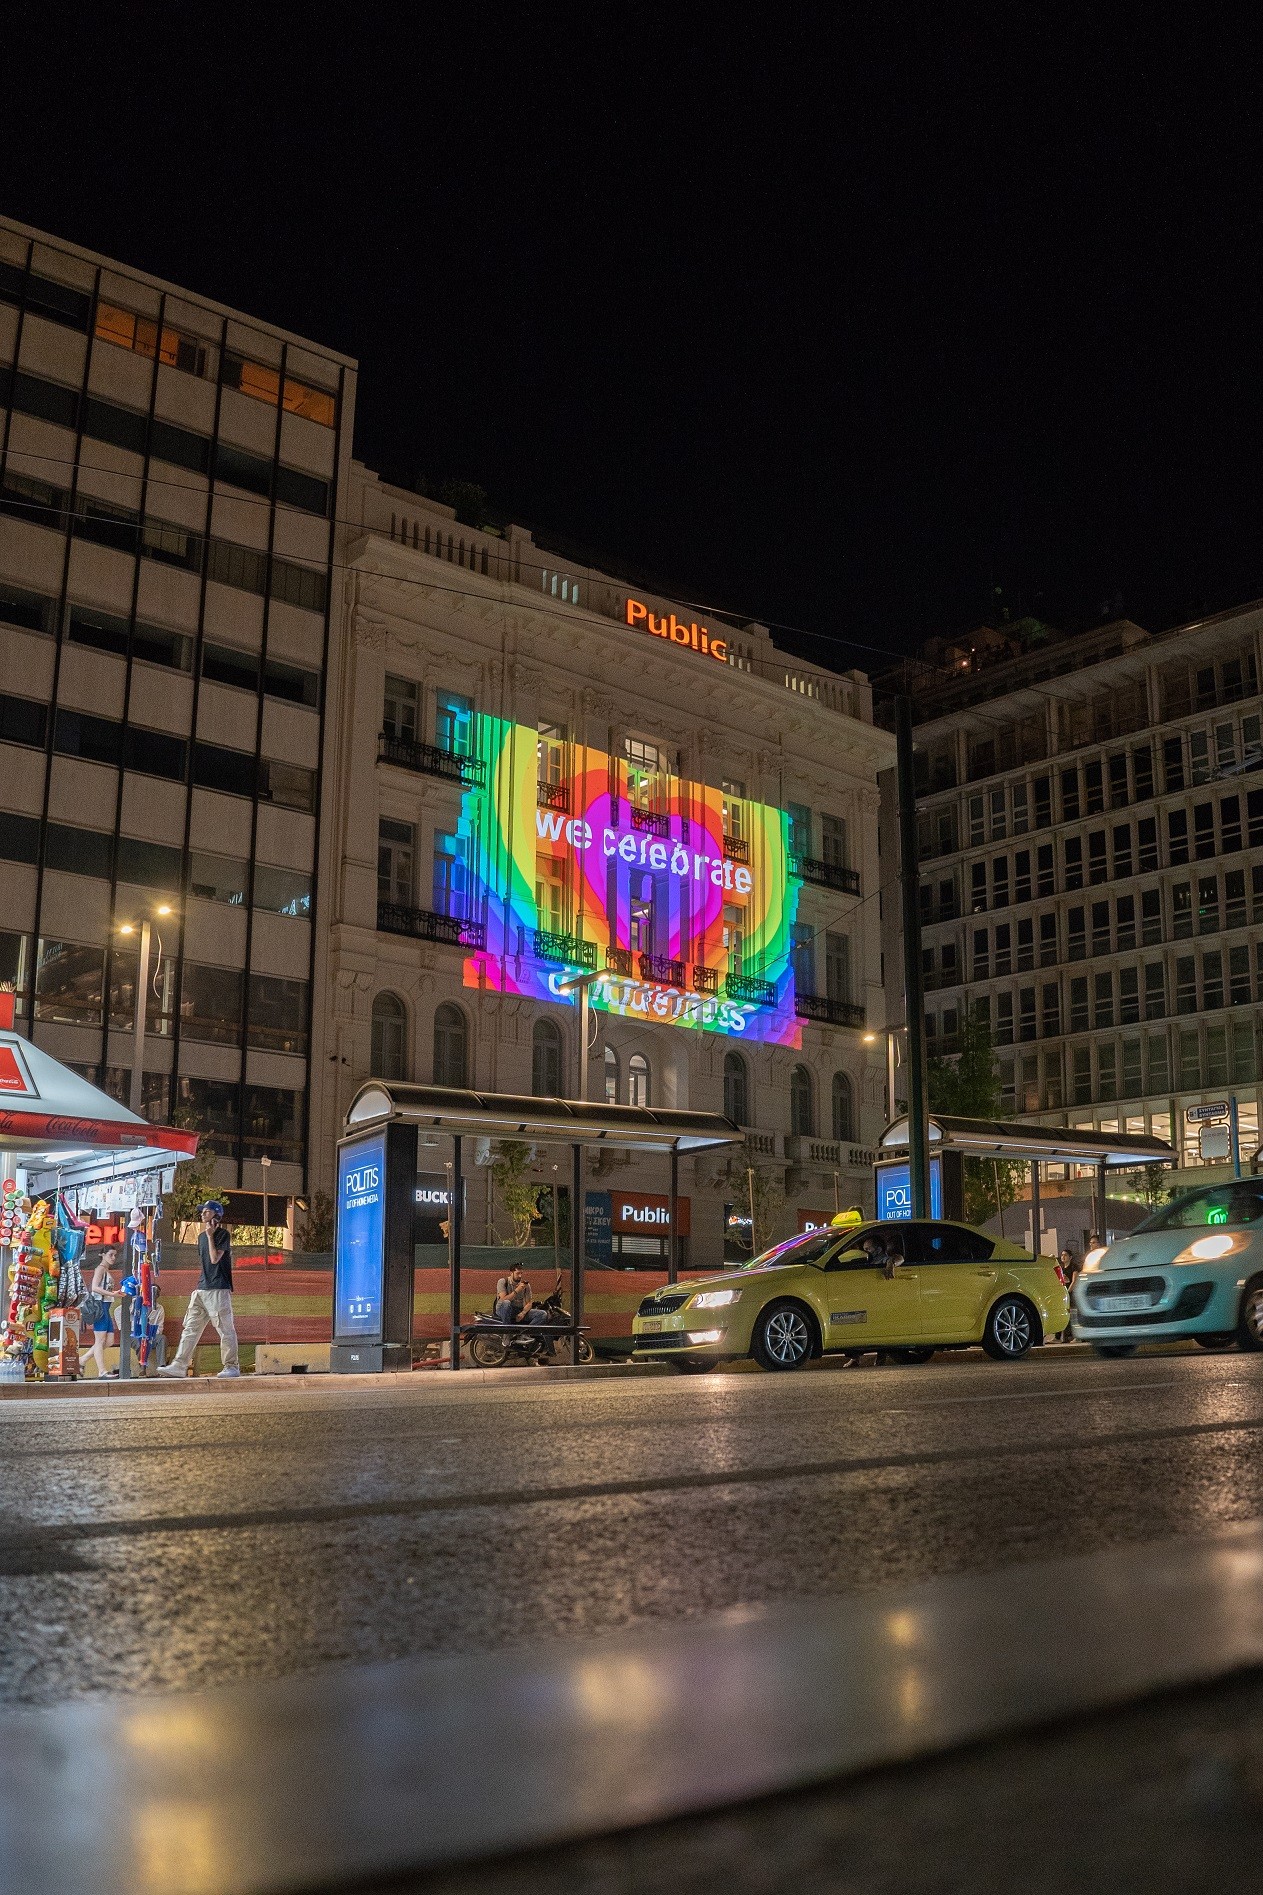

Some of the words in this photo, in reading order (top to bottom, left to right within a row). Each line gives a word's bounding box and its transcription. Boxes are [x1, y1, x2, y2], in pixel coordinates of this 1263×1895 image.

[626, 598, 727, 662] Public
[536, 809, 593, 849] we
[603, 828, 753, 894] celebrate
[45, 1115, 100, 1138] Coca-Cola
[346, 1167, 379, 1195] POLITIS
[415, 1189, 453, 1205] BUCK
[886, 1188, 911, 1207] POL
[886, 1210, 895, 1219] OUT
[896, 1210, 902, 1218] OF
